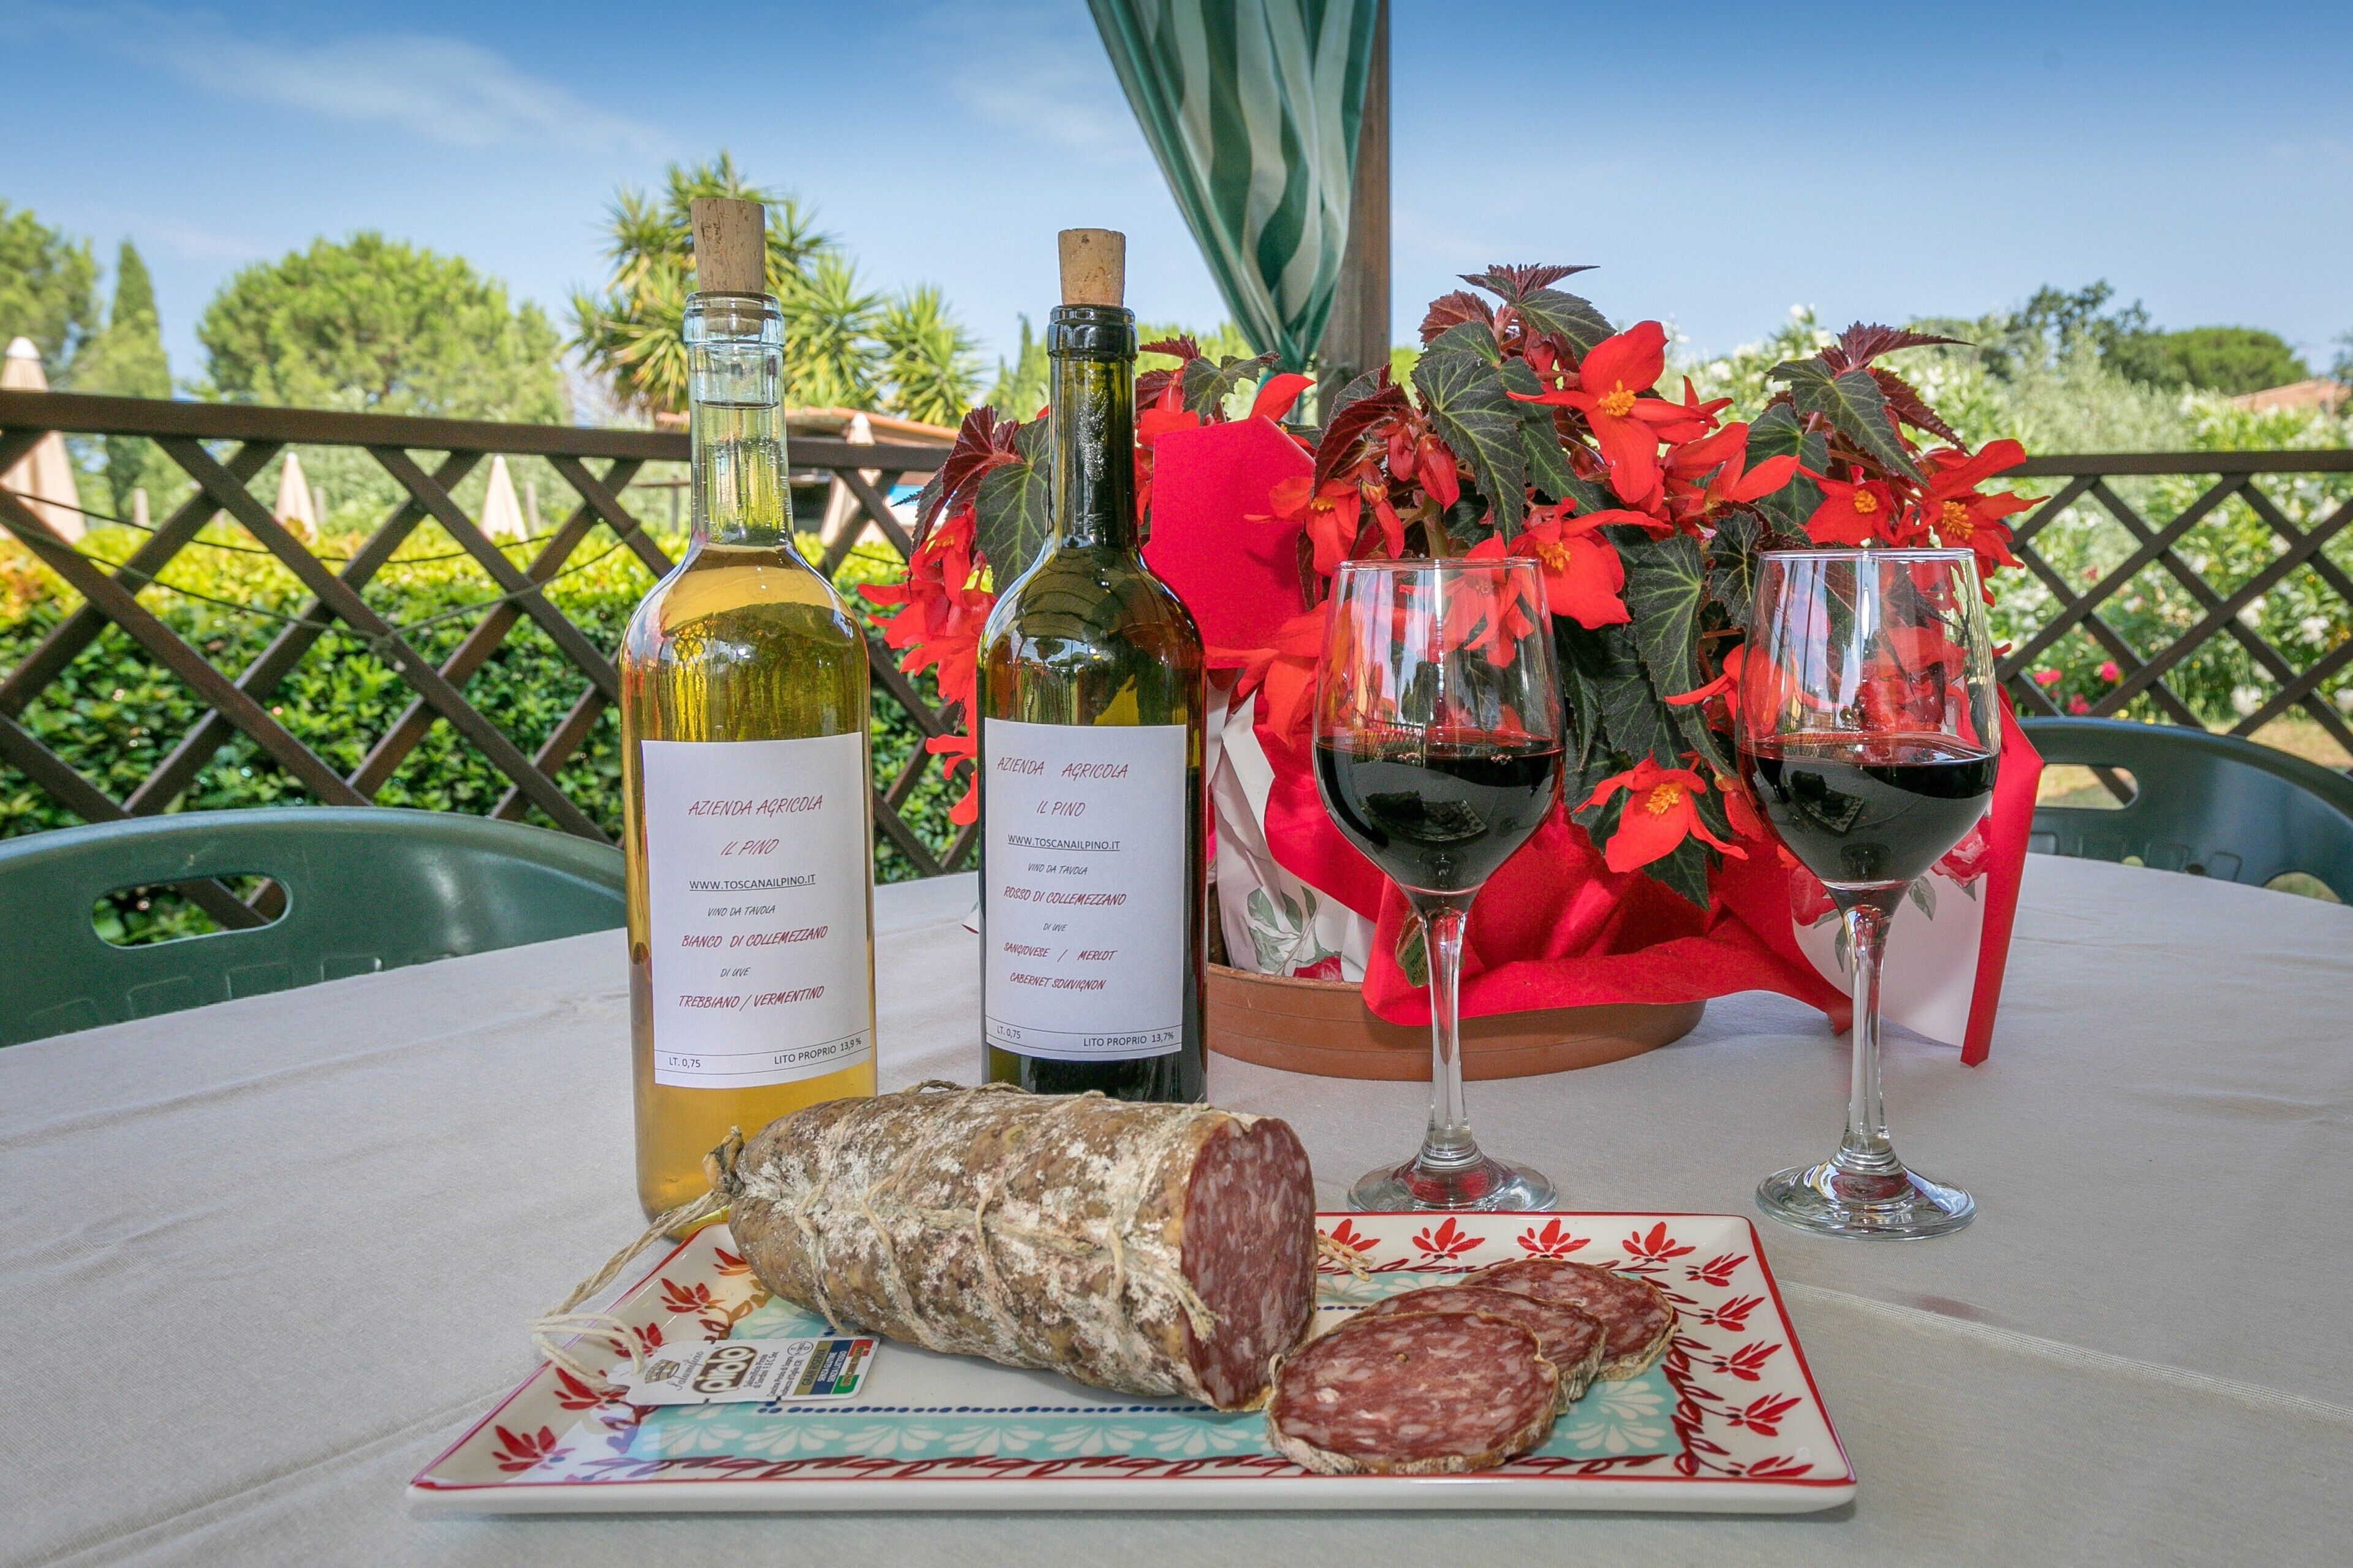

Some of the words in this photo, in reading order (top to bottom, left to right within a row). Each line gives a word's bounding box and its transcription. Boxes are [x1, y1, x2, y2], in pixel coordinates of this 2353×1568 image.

[997, 757, 1045, 776] AZIENDA
[1061, 763, 1129, 781] AGRICOLA
[688, 800, 752, 816] AZIENDA
[756, 795, 823, 817] AGRICOLA
[1036, 800, 1048, 814] IL
[1051, 801, 1086, 817] PINO
[721, 841, 737, 855] IL
[738, 839, 779, 855] PINO
[1007, 834, 1120, 851] WWW.TOSCANAILPINO.IT
[1028, 863, 1044, 873] VINO
[1046, 865, 1056, 874] DA
[1058, 865, 1088, 875] TAVOLA
[689, 874, 816, 890] WWW.TOSCANAILPINO.IT
[1003, 886, 1031, 901] ROSSO
[1033, 890, 1044, 902] DI
[1046, 892, 1127, 906] COLLEMEZZANO
[708, 907, 726, 917] VINO
[729, 907, 741, 916] DA
[745, 905, 776, 915] TAVOLA
[1043, 923, 1051, 931] DI
[1051, 923, 1068, 932] UVE
[681, 934, 723, 948] BIANCO
[730, 934, 745, 947] DI
[745, 925, 828, 947] COLLEMEZZANO
[1003, 942, 1051, 958] SANGIOVESE
[1057, 949, 1068, 963] /
[1077, 950, 1118, 961] MERLOT
[720, 968, 732, 978] DI
[732, 967, 751, 977] UVE
[1010, 972, 1052, 987] CABERNET
[1051, 979, 1107, 993] SOUVIGNON
[678, 995, 740, 1009] TREBBIANO
[739, 994, 752, 1012] /
[754, 986, 824, 1007] VERMENTINO
[1006, 1028, 1021, 1039] 0,75
[1083, 1037, 1104, 1047] LITO
[1107, 1036, 1147, 1046] PROPRIO
[1151, 1031, 1174, 1043] 13,7%
[669, 1057, 680, 1066] LT.
[682, 1058, 701, 1069] 0,75
[774, 1054, 796, 1066] LITO
[798, 1045, 837, 1061] PROPRIO
[801, 1370, 815, 1385] GRAN
